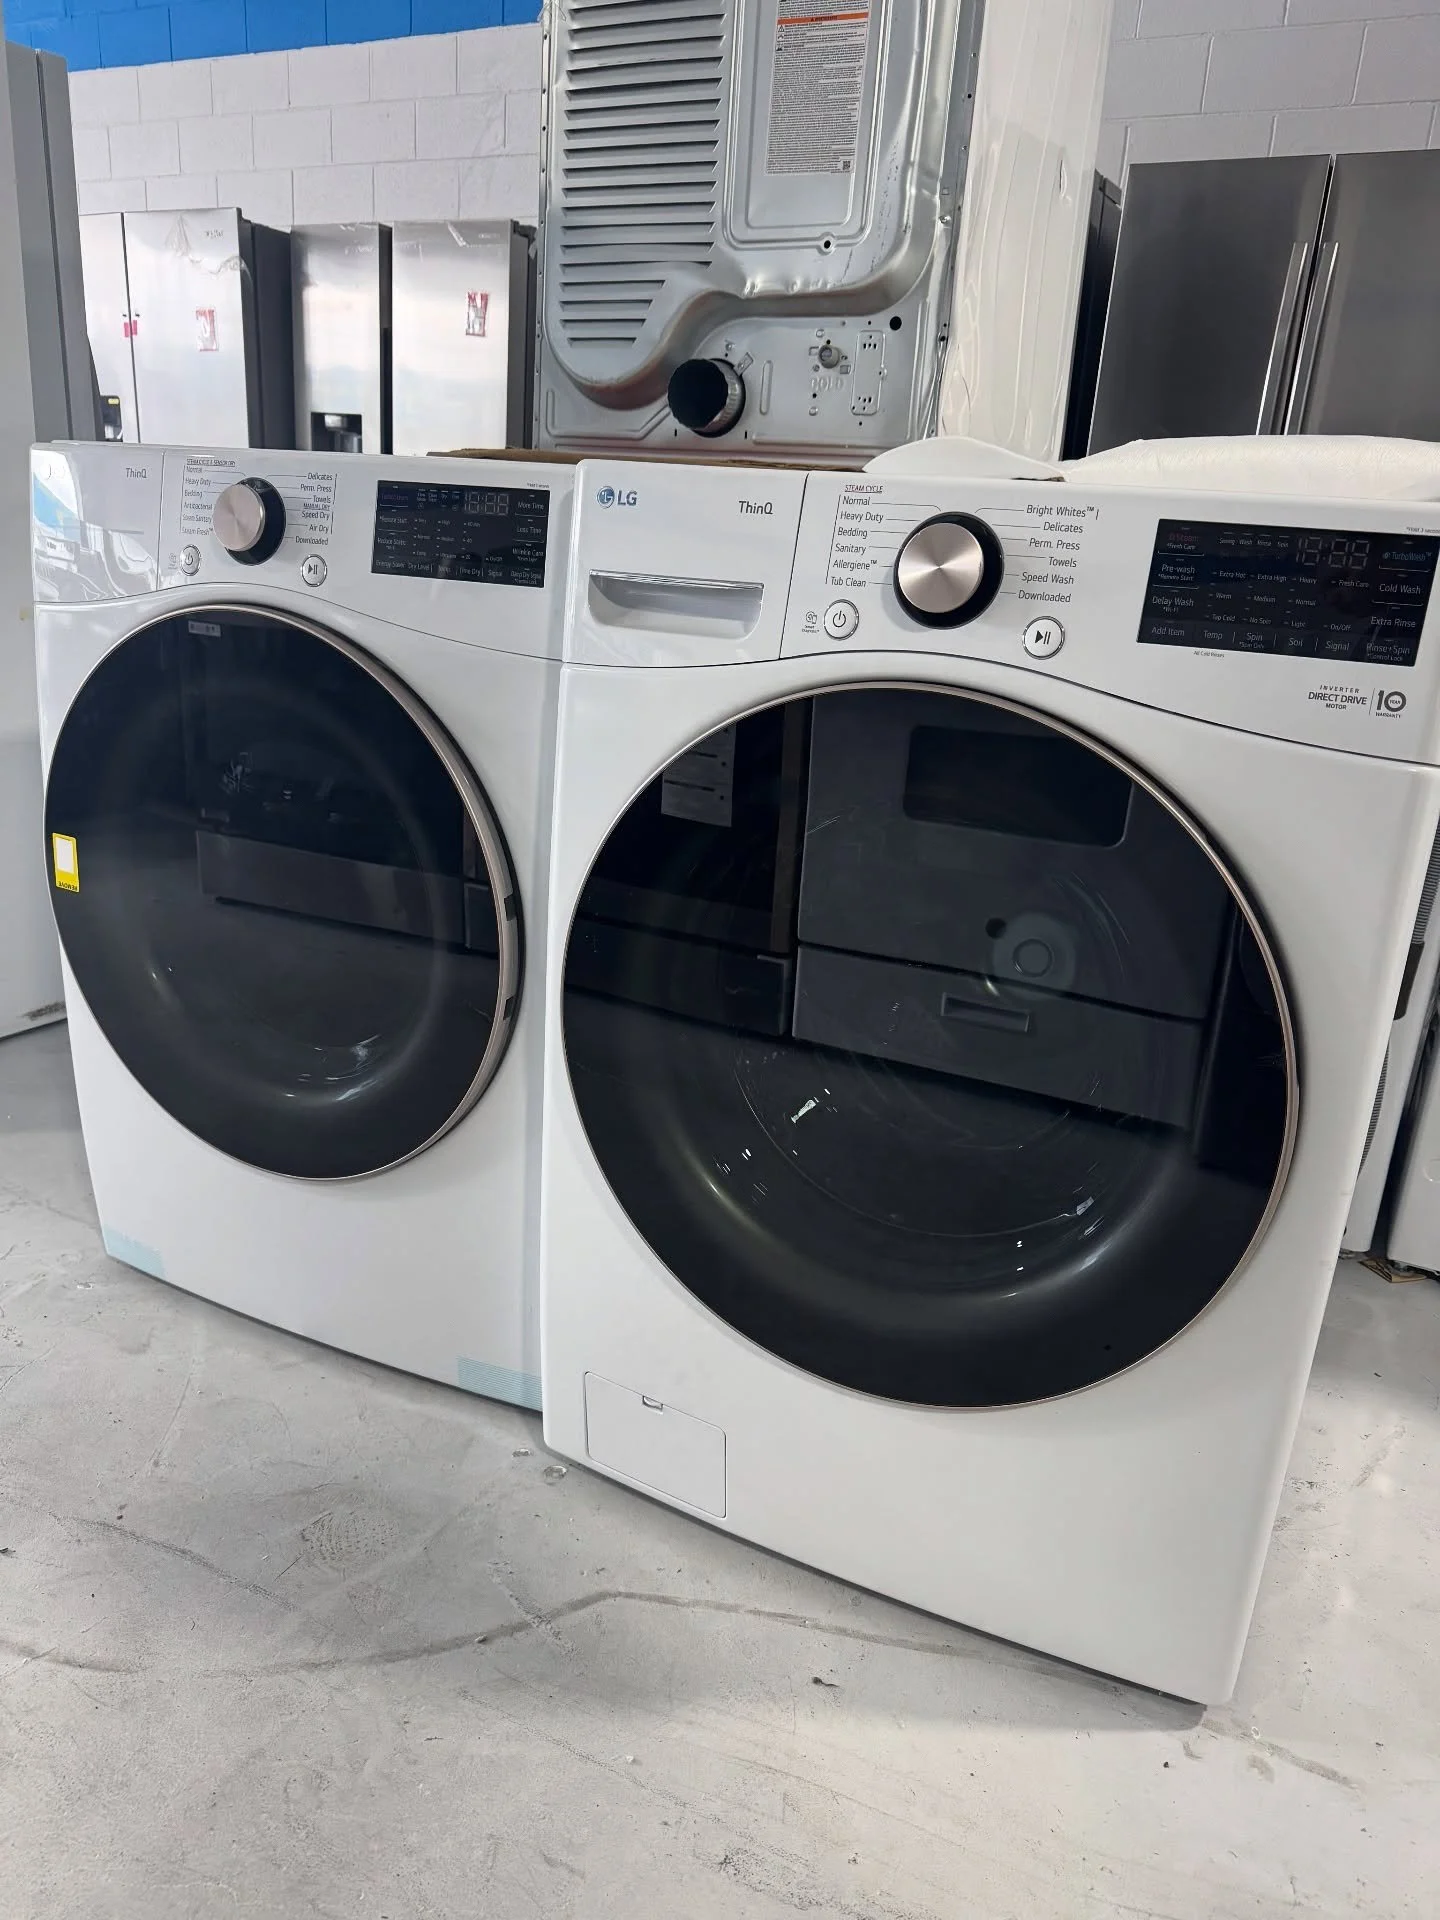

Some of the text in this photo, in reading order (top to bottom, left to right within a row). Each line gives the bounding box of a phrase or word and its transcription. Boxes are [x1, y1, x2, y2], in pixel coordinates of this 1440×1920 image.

[126, 467, 147, 479] ThinQ
[308, 472, 332, 480] Delicates
[186, 478, 211, 486] Heavy Duty
[300, 484, 332, 492] Perm. Press
[844, 484, 864, 492] STEAM
[184, 490, 202, 499] Bedding
[313, 495, 331, 503] Towels
[618, 490, 638, 506] LG
[184, 502, 212, 510] Antibacterial
[532, 502, 544, 510] Time
[842, 496, 870, 506] Normal
[738, 500, 774, 515] ThinQ
[1026, 504, 1052, 517] Bright
[196, 515, 212, 524] Sanitary
[320, 512, 330, 520] Dry
[840, 512, 884, 523] Heavy Duty
[309, 524, 328, 534] Air Dry
[838, 526, 868, 539] Bedding
[1044, 522, 1084, 534] Delicates
[296, 536, 328, 545] Downloaded
[1029, 538, 1080, 550] Perm. Press
[835, 543, 866, 556] Sanitary
[408, 562, 417, 570] Dry
[1049, 556, 1077, 568] Towels
[1162, 564, 1196, 574] Pre-wash
[1220, 570, 1234, 578] Extra
[830, 576, 866, 588] Tub Clean
[1022, 572, 1074, 584] Speed Wash
[1356, 580, 1369, 588] Care
[1380, 584, 1420, 594] Cold Wash
[1018, 590, 1072, 603] Downloaded
[1152, 596, 1194, 606] Delay Wash
[1216, 592, 1232, 600] Warm
[1222, 614, 1236, 622] Cold
[1370, 616, 1416, 628] Extra Rinse
[1290, 620, 1306, 628] Light
[1152, 626, 1184, 636] Add Item
[1204, 630, 1222, 640] Temp
[1246, 632, 1263, 642] Spin
[1288, 638, 1303, 647] Soil
[1325, 640, 1350, 652] Signal
[1320, 684, 1360, 694] INVERTER
[1308, 692, 1368, 705] DIRECT DRIVE
[1376, 690, 1406, 712] 10
